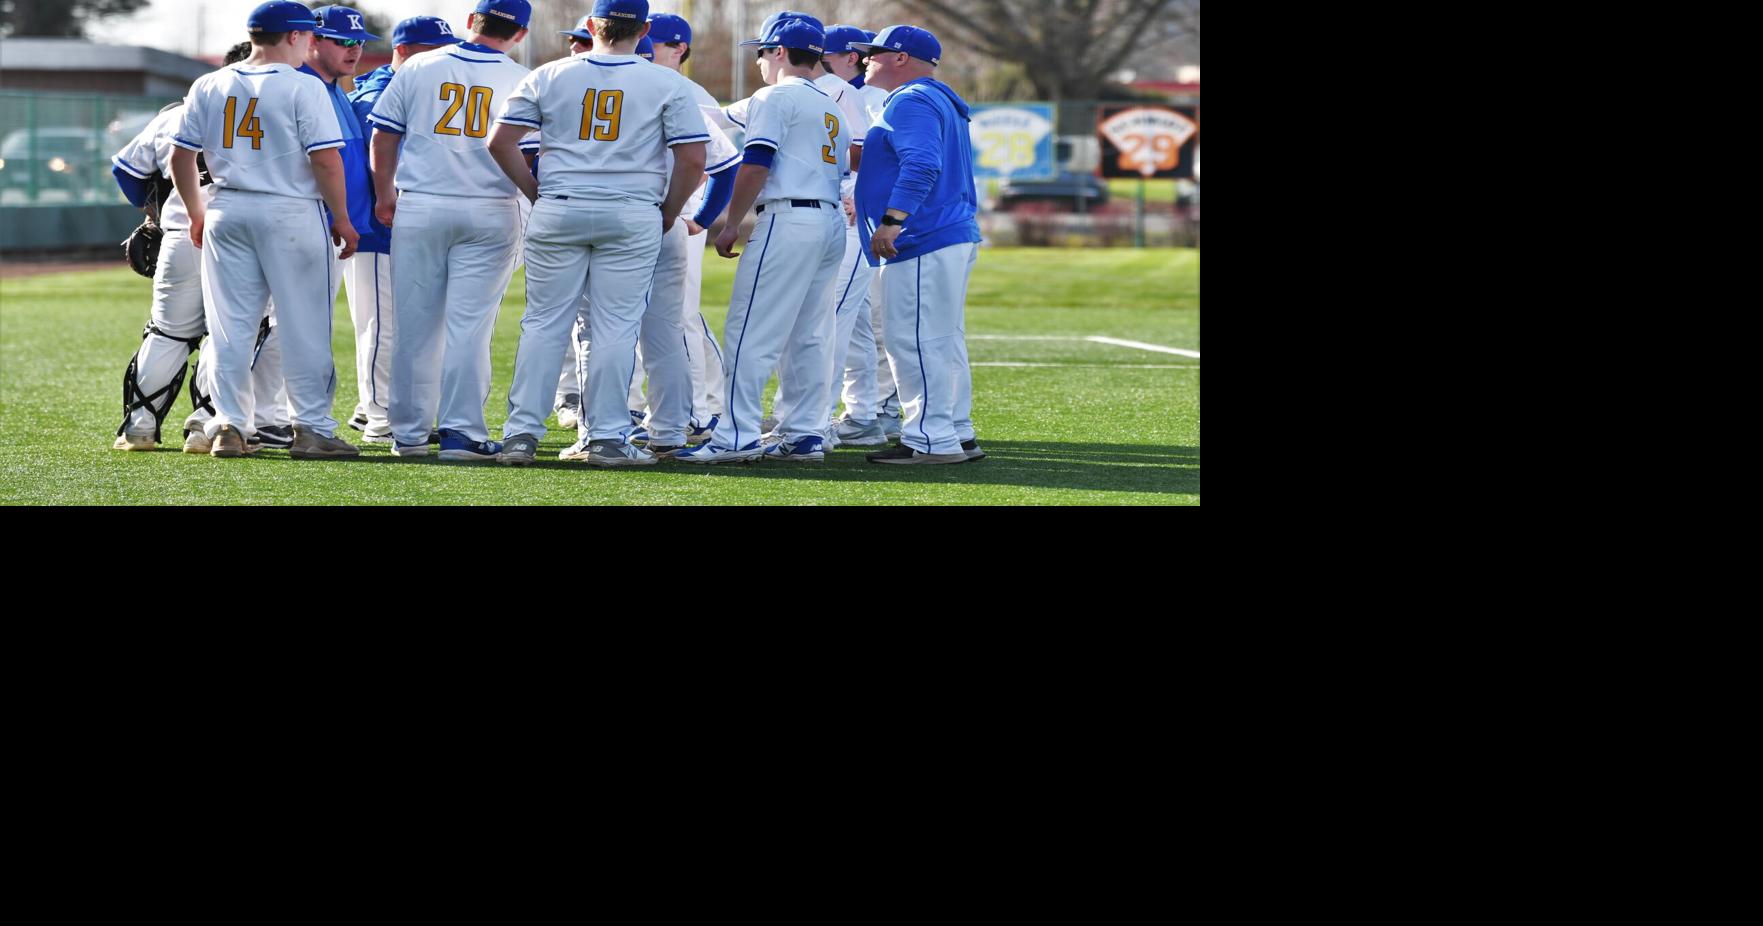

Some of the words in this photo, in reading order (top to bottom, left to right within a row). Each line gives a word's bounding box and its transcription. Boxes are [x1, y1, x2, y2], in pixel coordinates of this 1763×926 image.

[347, 14, 363, 30] K
[435, 20, 454, 35] K
[222, 96, 264, 150] 14
[434, 82, 494, 138] 20
[579, 88, 624, 141] 19
[821, 112, 840, 164] 3
[978, 131, 1036, 168] 28
[1118, 133, 1179, 171] 29
